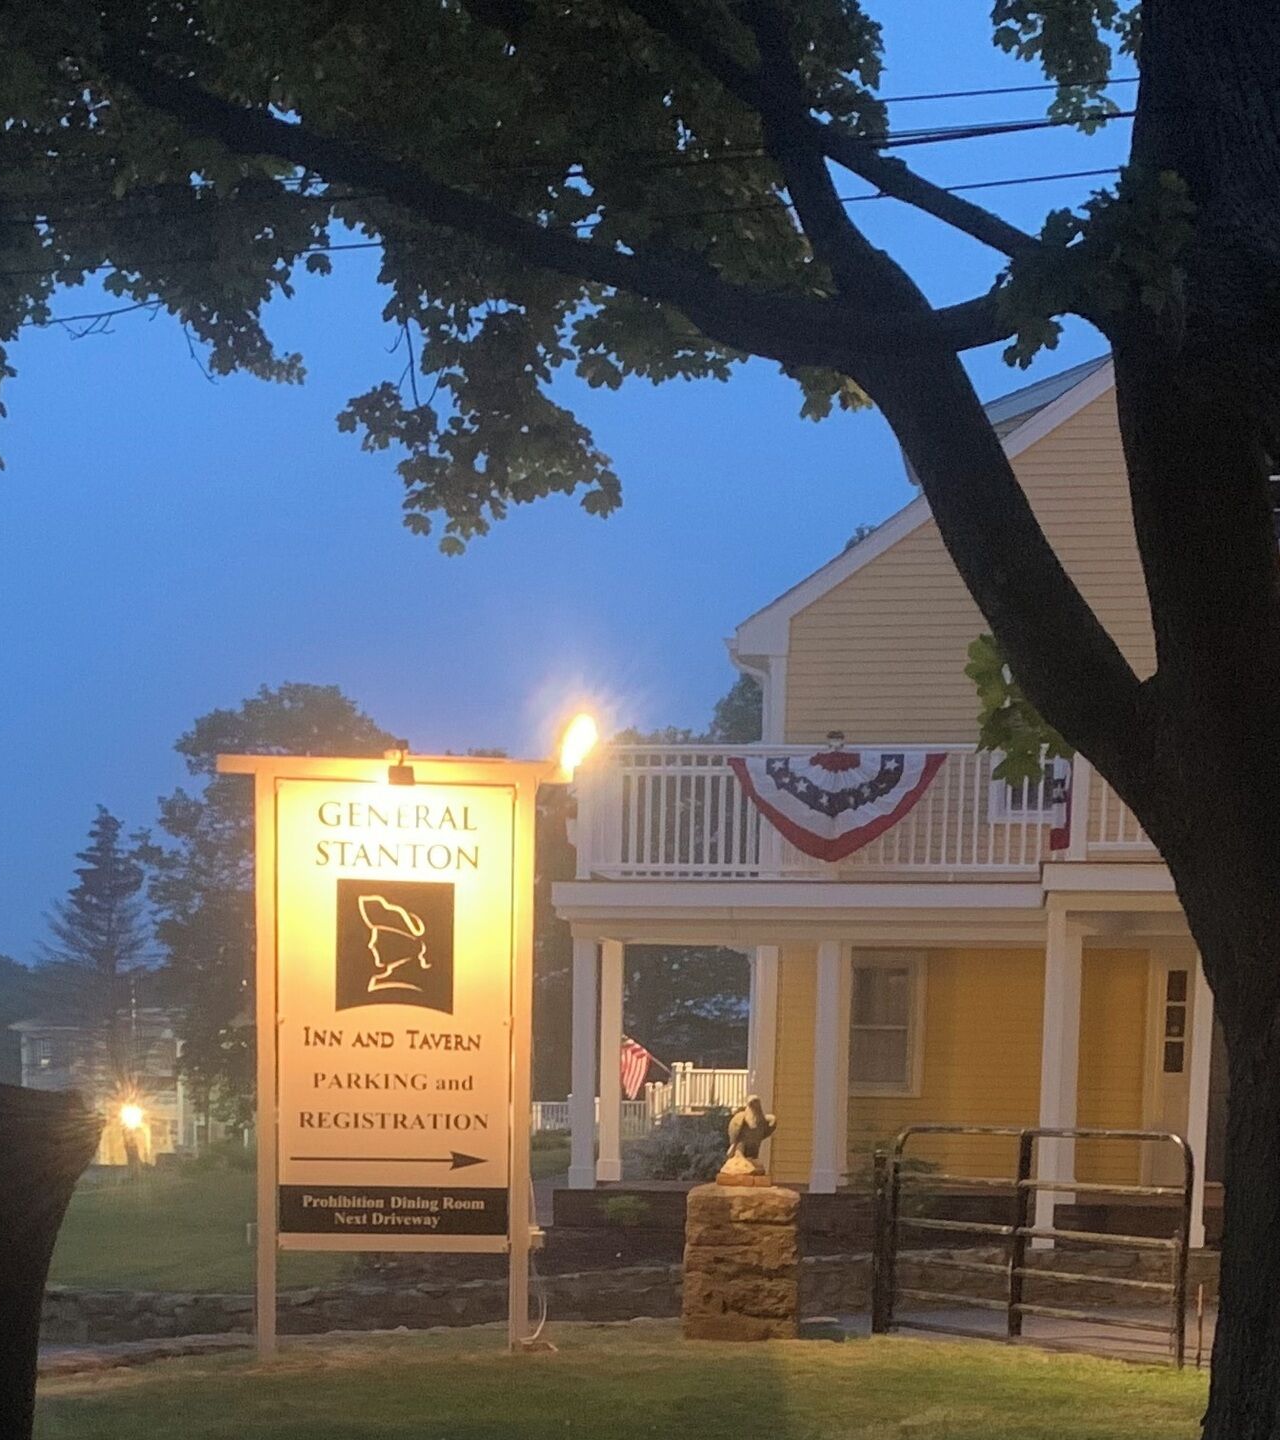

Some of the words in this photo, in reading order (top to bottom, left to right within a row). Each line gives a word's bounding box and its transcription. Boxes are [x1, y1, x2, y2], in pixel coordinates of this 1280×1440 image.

[318, 801, 478, 831] GENERAL
[315, 841, 479, 870] STANTON
[351, 1031, 395, 1049] AND
[313, 1072, 428, 1091] PARKING
[435, 1075, 474, 1091] and
[299, 1111, 489, 1130] REGISTRATION
[302, 1195, 384, 1209] Prohibition
[390, 1196, 439, 1212] Dining
[442, 1197, 485, 1210] Room
[334, 1212, 368, 1225] Next
[372, 1212, 440, 1229] Driveway
